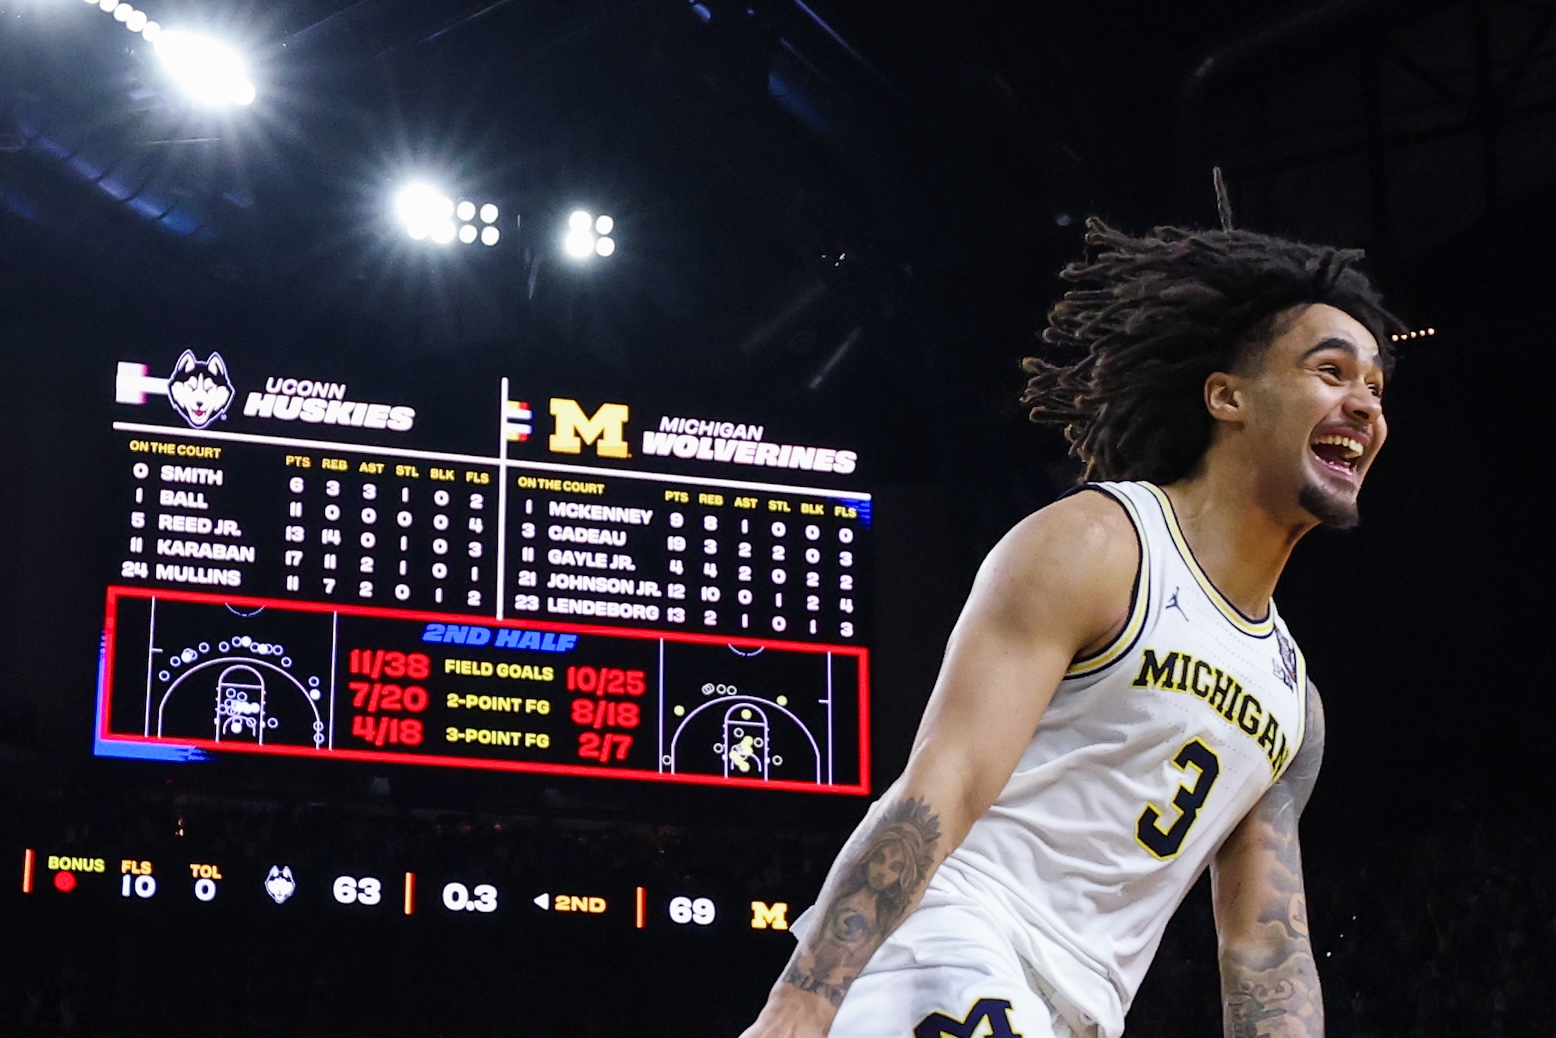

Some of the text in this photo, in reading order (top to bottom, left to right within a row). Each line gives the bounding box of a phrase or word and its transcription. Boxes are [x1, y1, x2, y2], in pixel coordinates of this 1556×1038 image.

[266, 376, 346, 400] UCONN
[243, 392, 416, 431] HUSKIES
[549, 397, 629, 459] M
[659, 416, 763, 441] MICHIGAN
[129, 440, 489, 484] ON THE COURT PTS REB AST STL BLK FLS
[642, 431, 857, 474] WOLVERINES
[133, 463, 483, 509] 0 SMITH 6 3 3 0 2
[518, 477, 856, 519] ON THE COURT PTS REB AST STL BLK FLS
[160, 490, 483, 533] BALL 11 0 0 0 0 4
[549, 501, 853, 543] MCKENNEY 9 8 0 0 0
[130, 538, 374, 573] 11 KARABAN 17 11 2
[131, 513, 482, 558] 5 REED JR. 13 14 0 3
[522, 523, 853, 567] 3 CADEAU 19 3 2 2 3
[121, 562, 481, 606] 24 MULLINS 11 7 2 2
[522, 547, 853, 590] 11 GAYLE JR. 4 4 2 2 2
[518, 571, 854, 614] 21 JOHNSON JR. 12 10 2 4
[422, 622, 578, 652] 2ND HALF
[515, 595, 854, 638] 23 LENDEBORG 13 2 3
[348, 648, 646, 696] 11/38 FIELD GOALS 10/25
[348, 681, 640, 729] 7/20 2-POINT FG 8/18
[1131, 649, 1289, 782] MICHIGAN
[352, 715, 633, 763] 4/18 3-POINT FG 2/7
[1134, 737, 1220, 860] 3
[48, 855, 105, 873] BONUS
[121, 860, 152, 874] FLS
[190, 863, 222, 879] TOL
[121, 874, 156, 898] 10
[195, 878, 216, 901] 0
[333, 875, 381, 905] 63
[442, 882, 498, 913] 0.3
[554, 895, 606, 914] 2ND
[669, 896, 716, 925] 69
[751, 901, 788, 930] M
